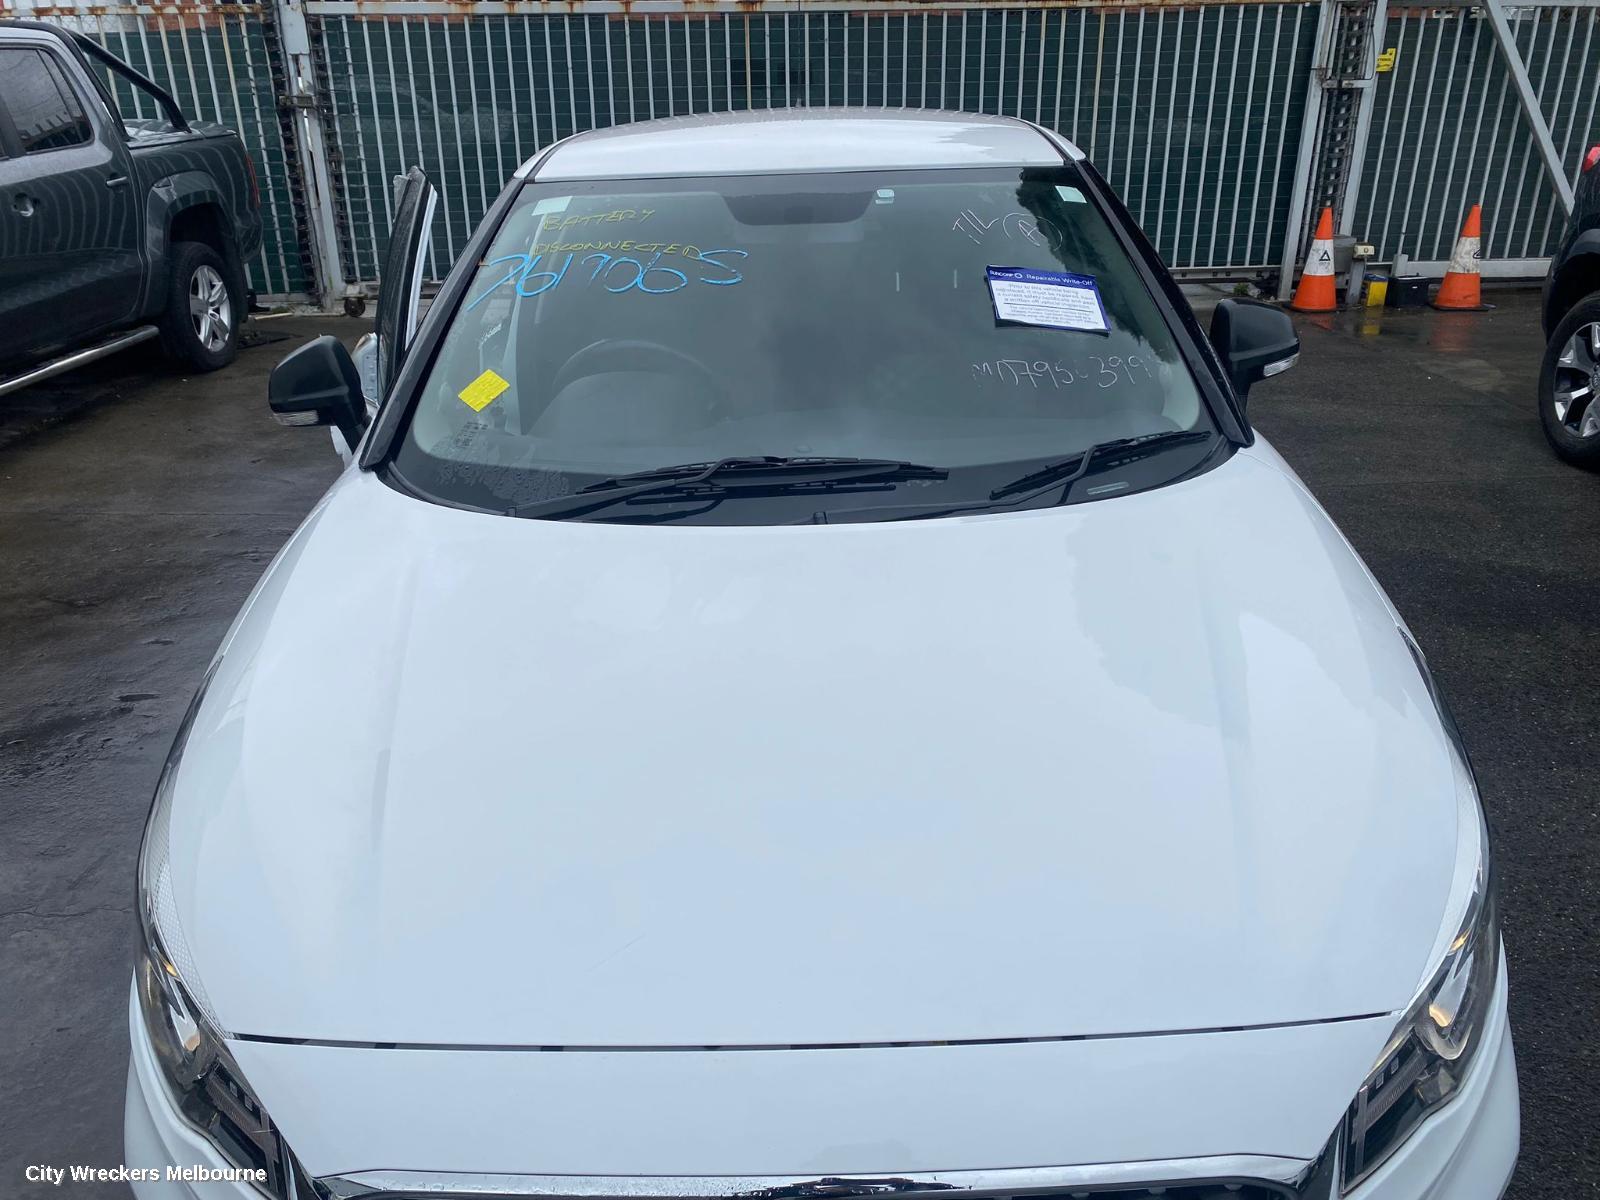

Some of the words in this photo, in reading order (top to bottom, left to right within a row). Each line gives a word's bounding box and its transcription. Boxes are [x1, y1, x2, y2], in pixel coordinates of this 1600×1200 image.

[543, 209, 655, 232] BATTERY
[534, 239, 702, 260] DISCONNECTED
[1026, 274, 1061, 282] Repairable
[1063, 278, 1093, 286] Write-Off
